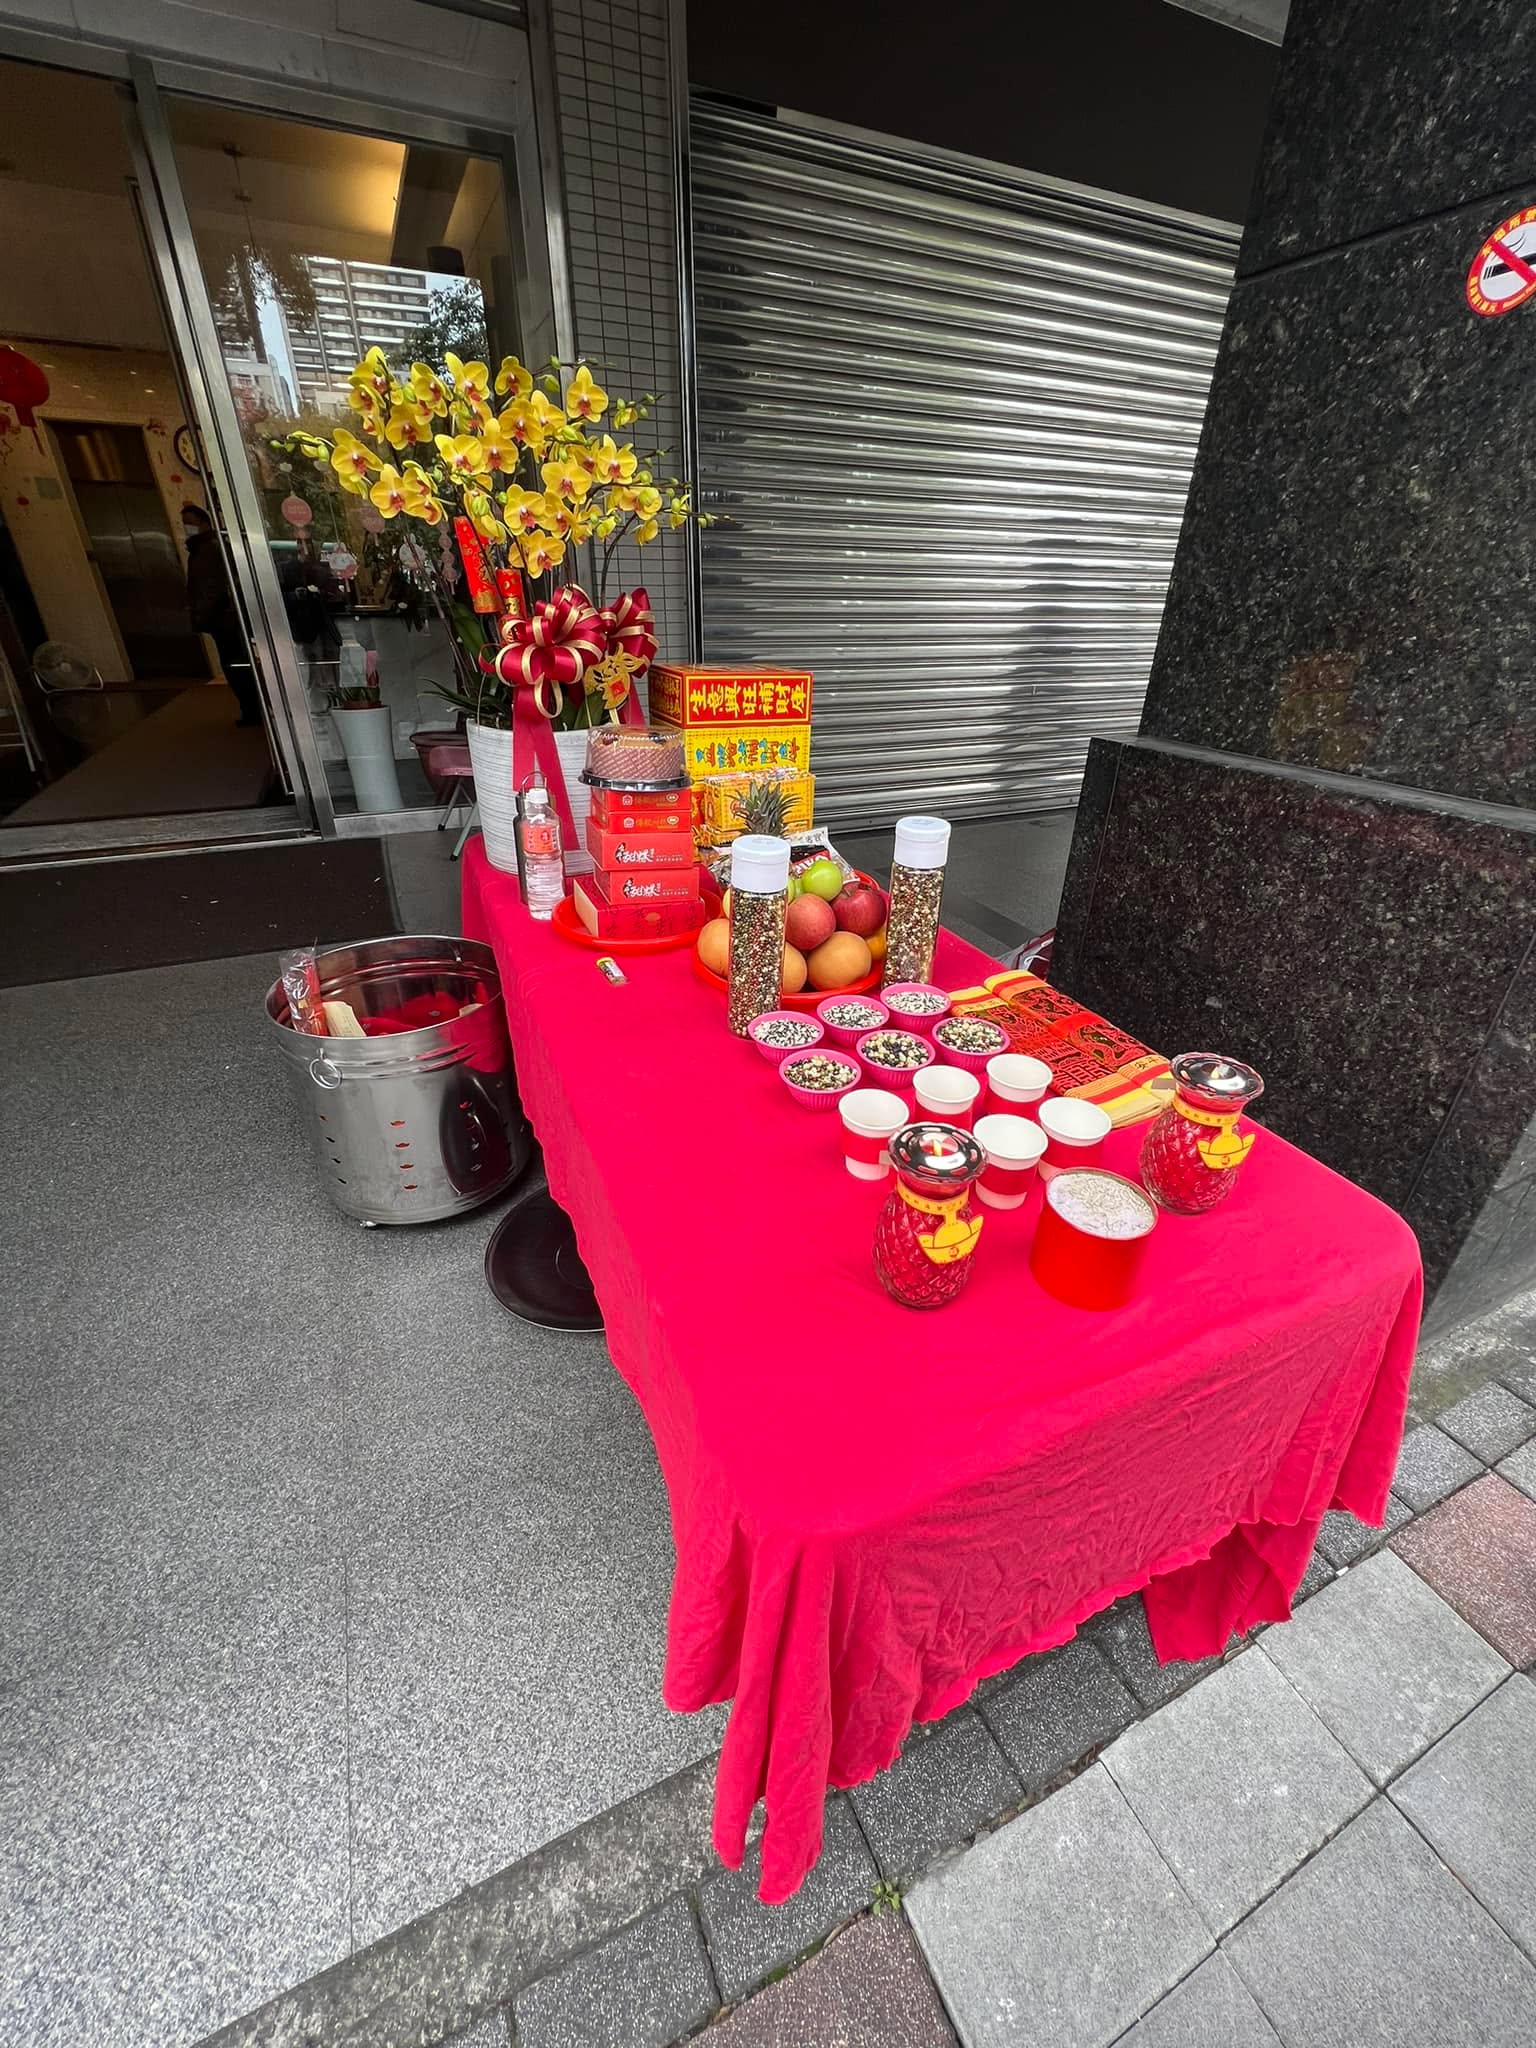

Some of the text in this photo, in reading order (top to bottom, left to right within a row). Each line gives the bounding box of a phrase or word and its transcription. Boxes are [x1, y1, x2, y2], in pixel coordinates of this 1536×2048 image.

[690, 681, 806, 718] 生意興旺補財庫
[695, 737, 800, 768] 五路補財庫
